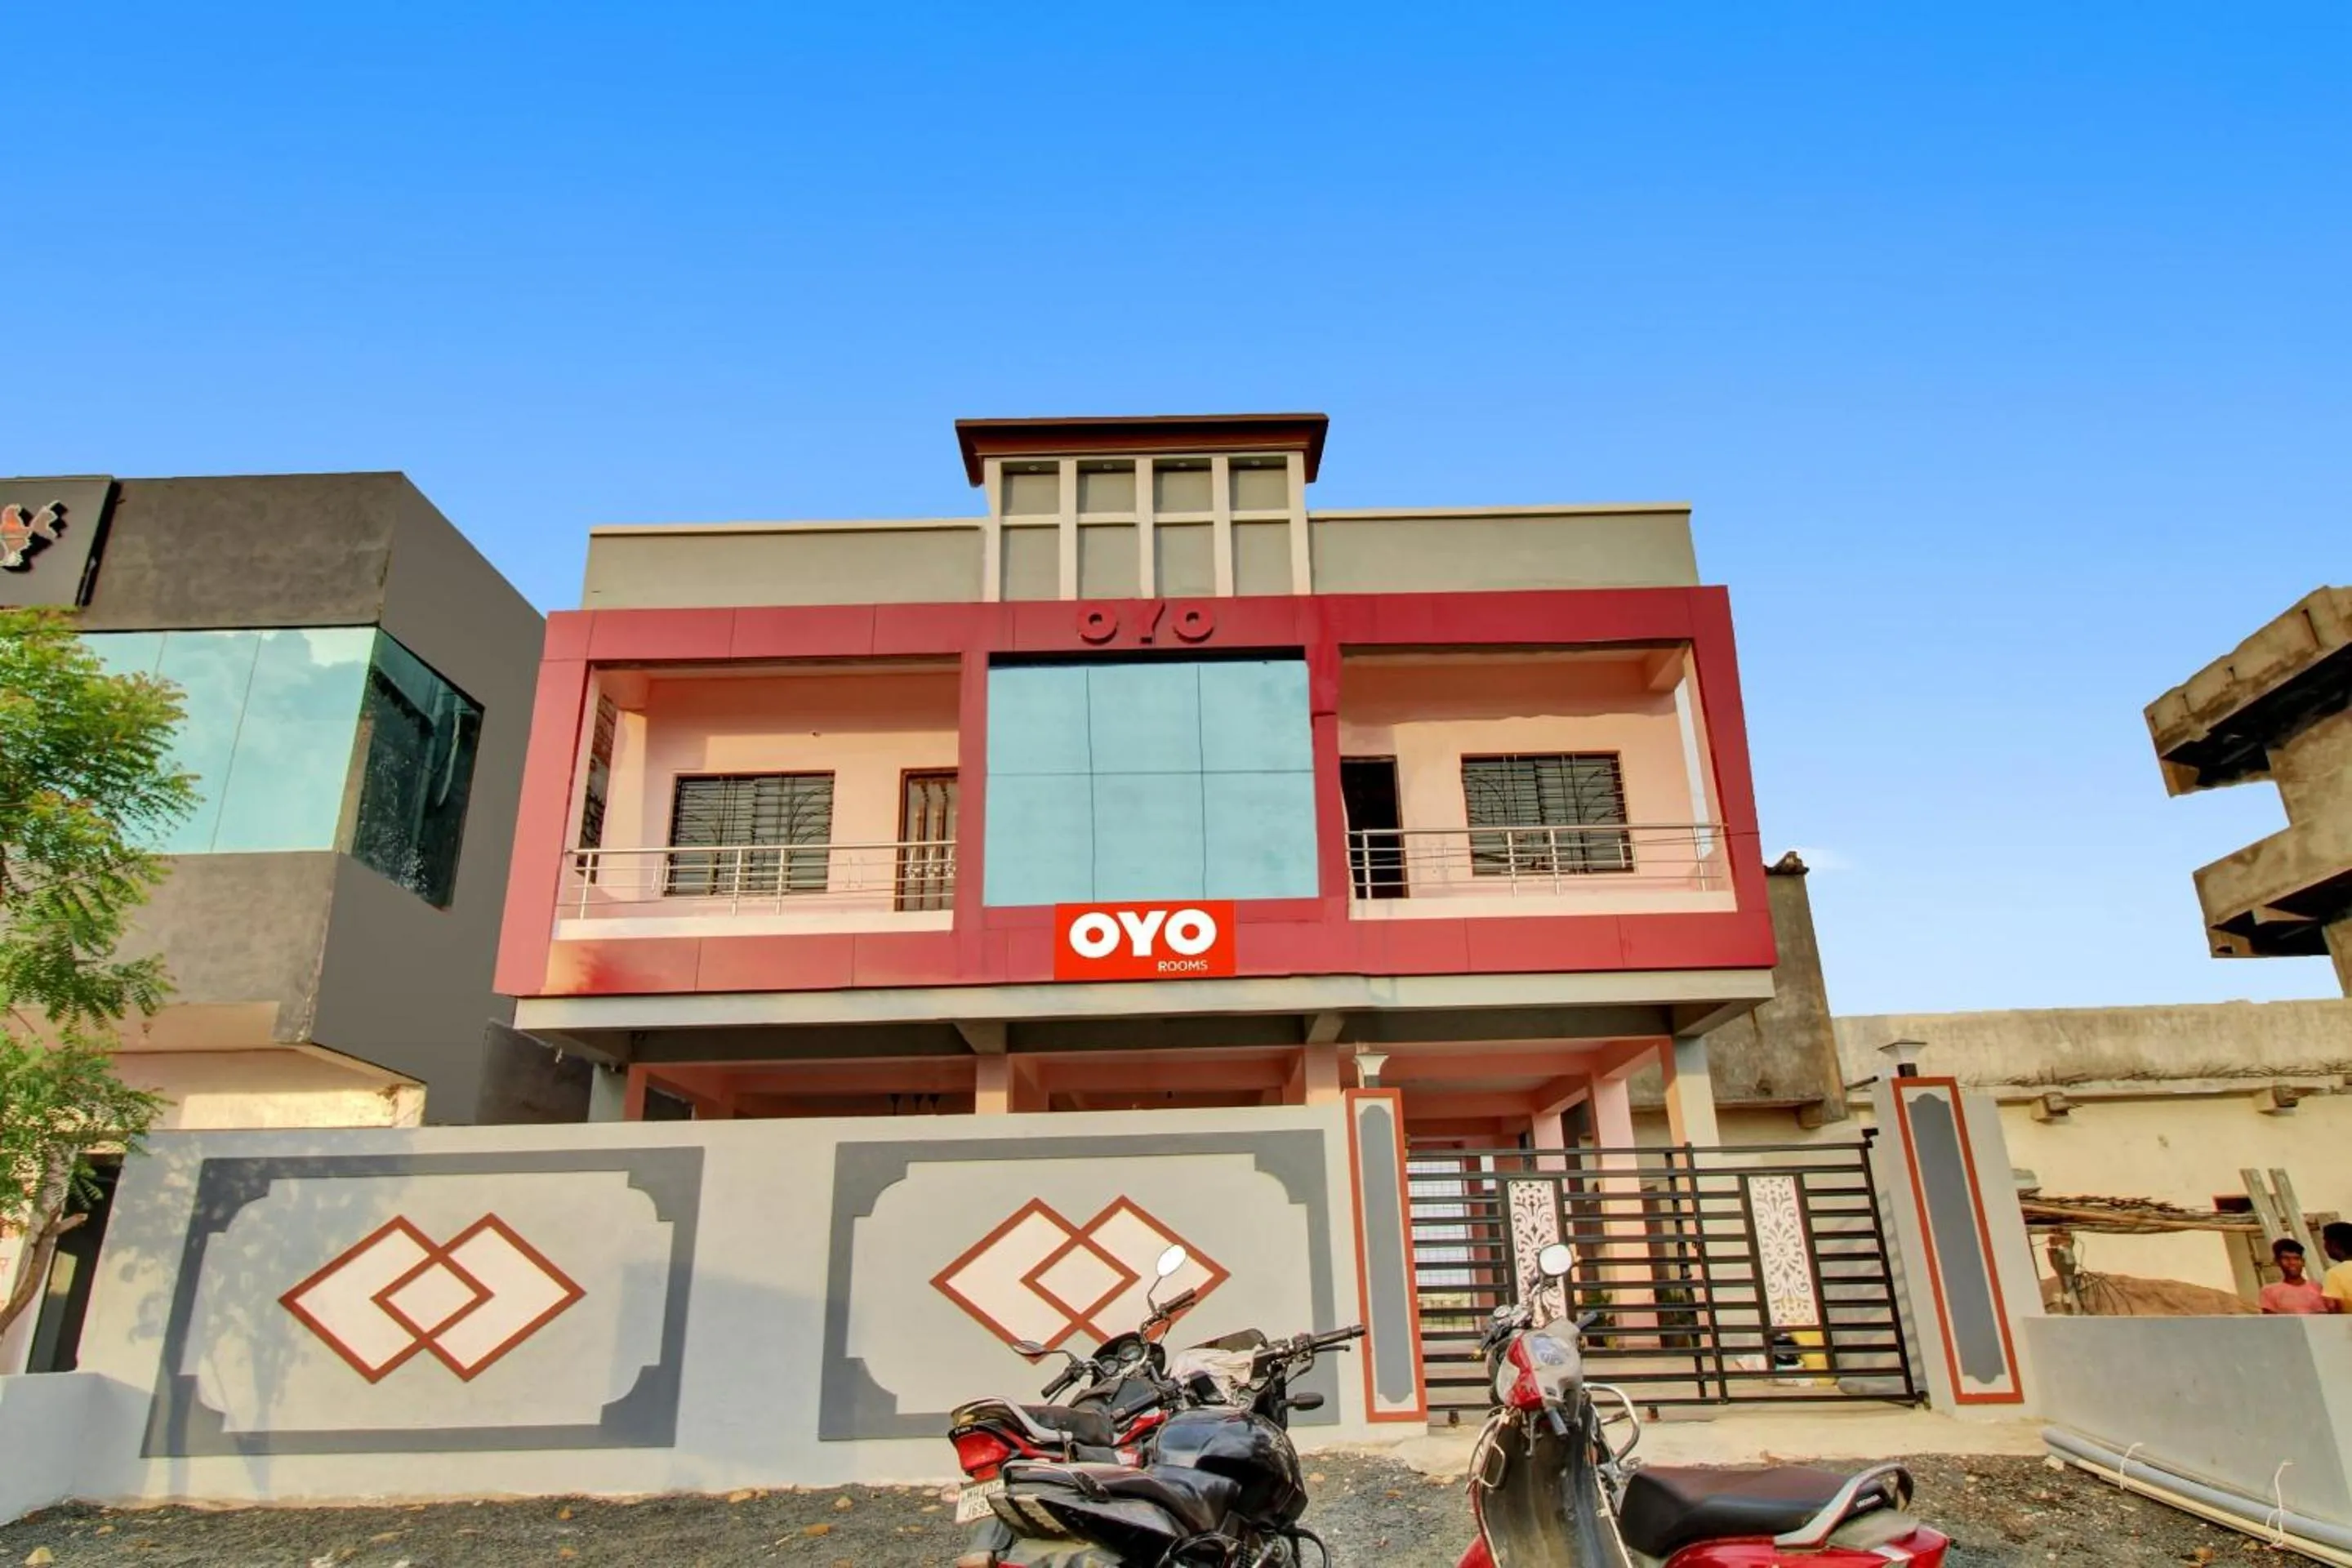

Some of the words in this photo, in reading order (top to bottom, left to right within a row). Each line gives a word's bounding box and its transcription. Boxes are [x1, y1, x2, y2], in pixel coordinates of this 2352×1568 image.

[1076, 599, 1216, 645] OYO
[1069, 908, 1218, 959] OYO
[1156, 960, 1209, 972] ROOMS
